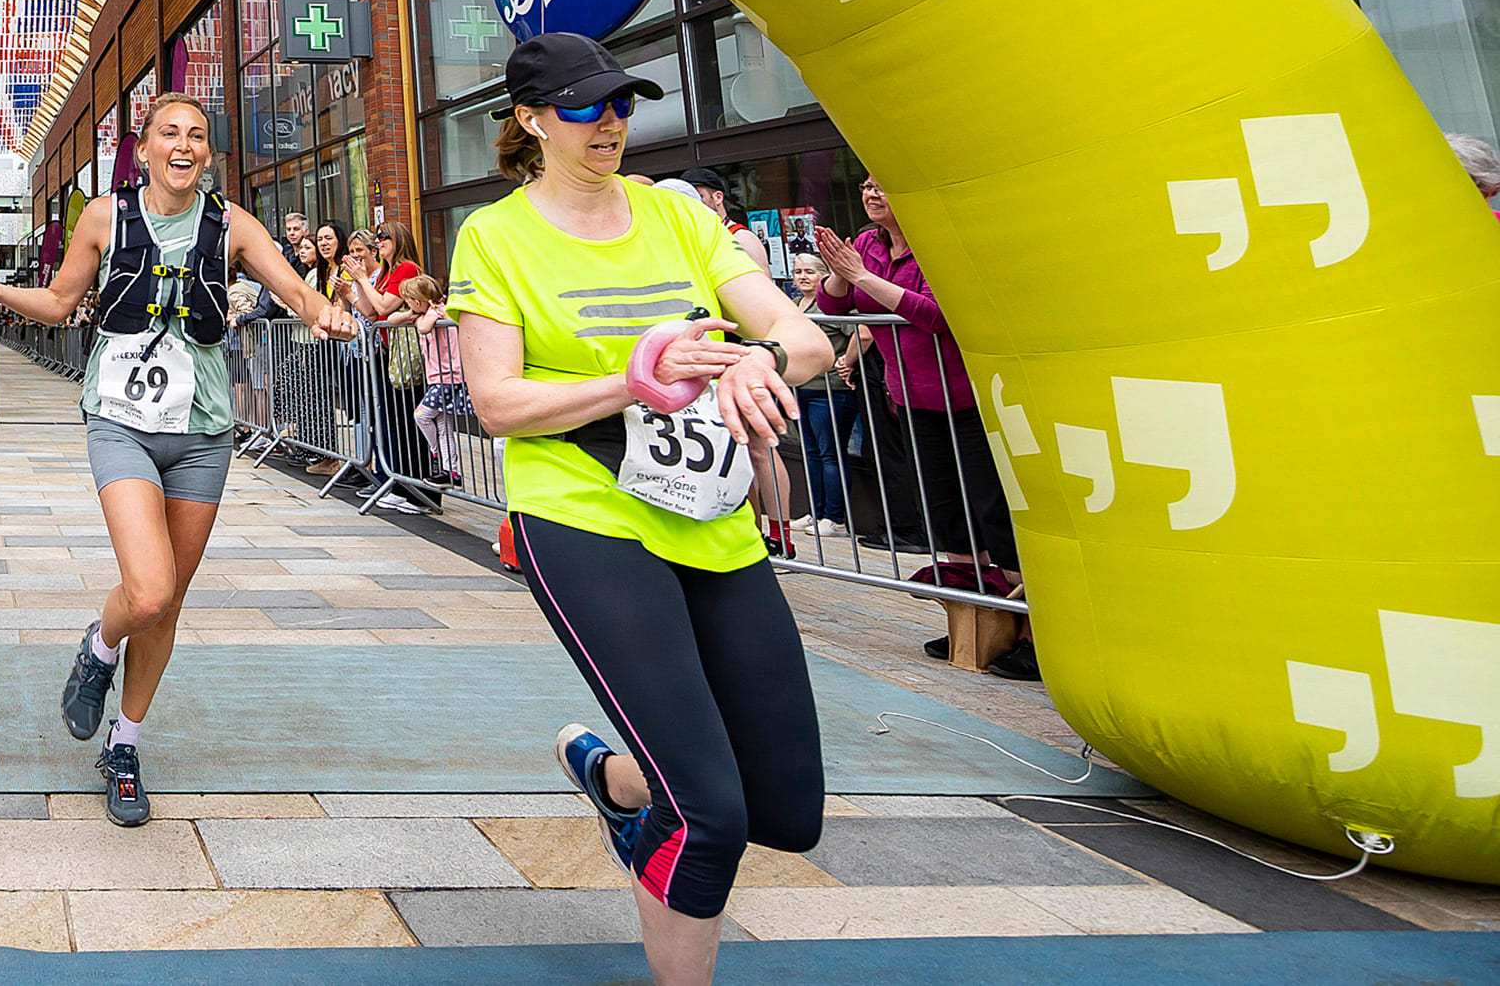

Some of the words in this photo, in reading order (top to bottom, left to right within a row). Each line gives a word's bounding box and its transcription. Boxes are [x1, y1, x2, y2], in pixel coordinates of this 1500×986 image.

[124, 365, 169, 403] 69
[643, 412, 738, 479] 357
[636, 471, 698, 494] everyone
[662, 488, 697, 503] ACTIVE
